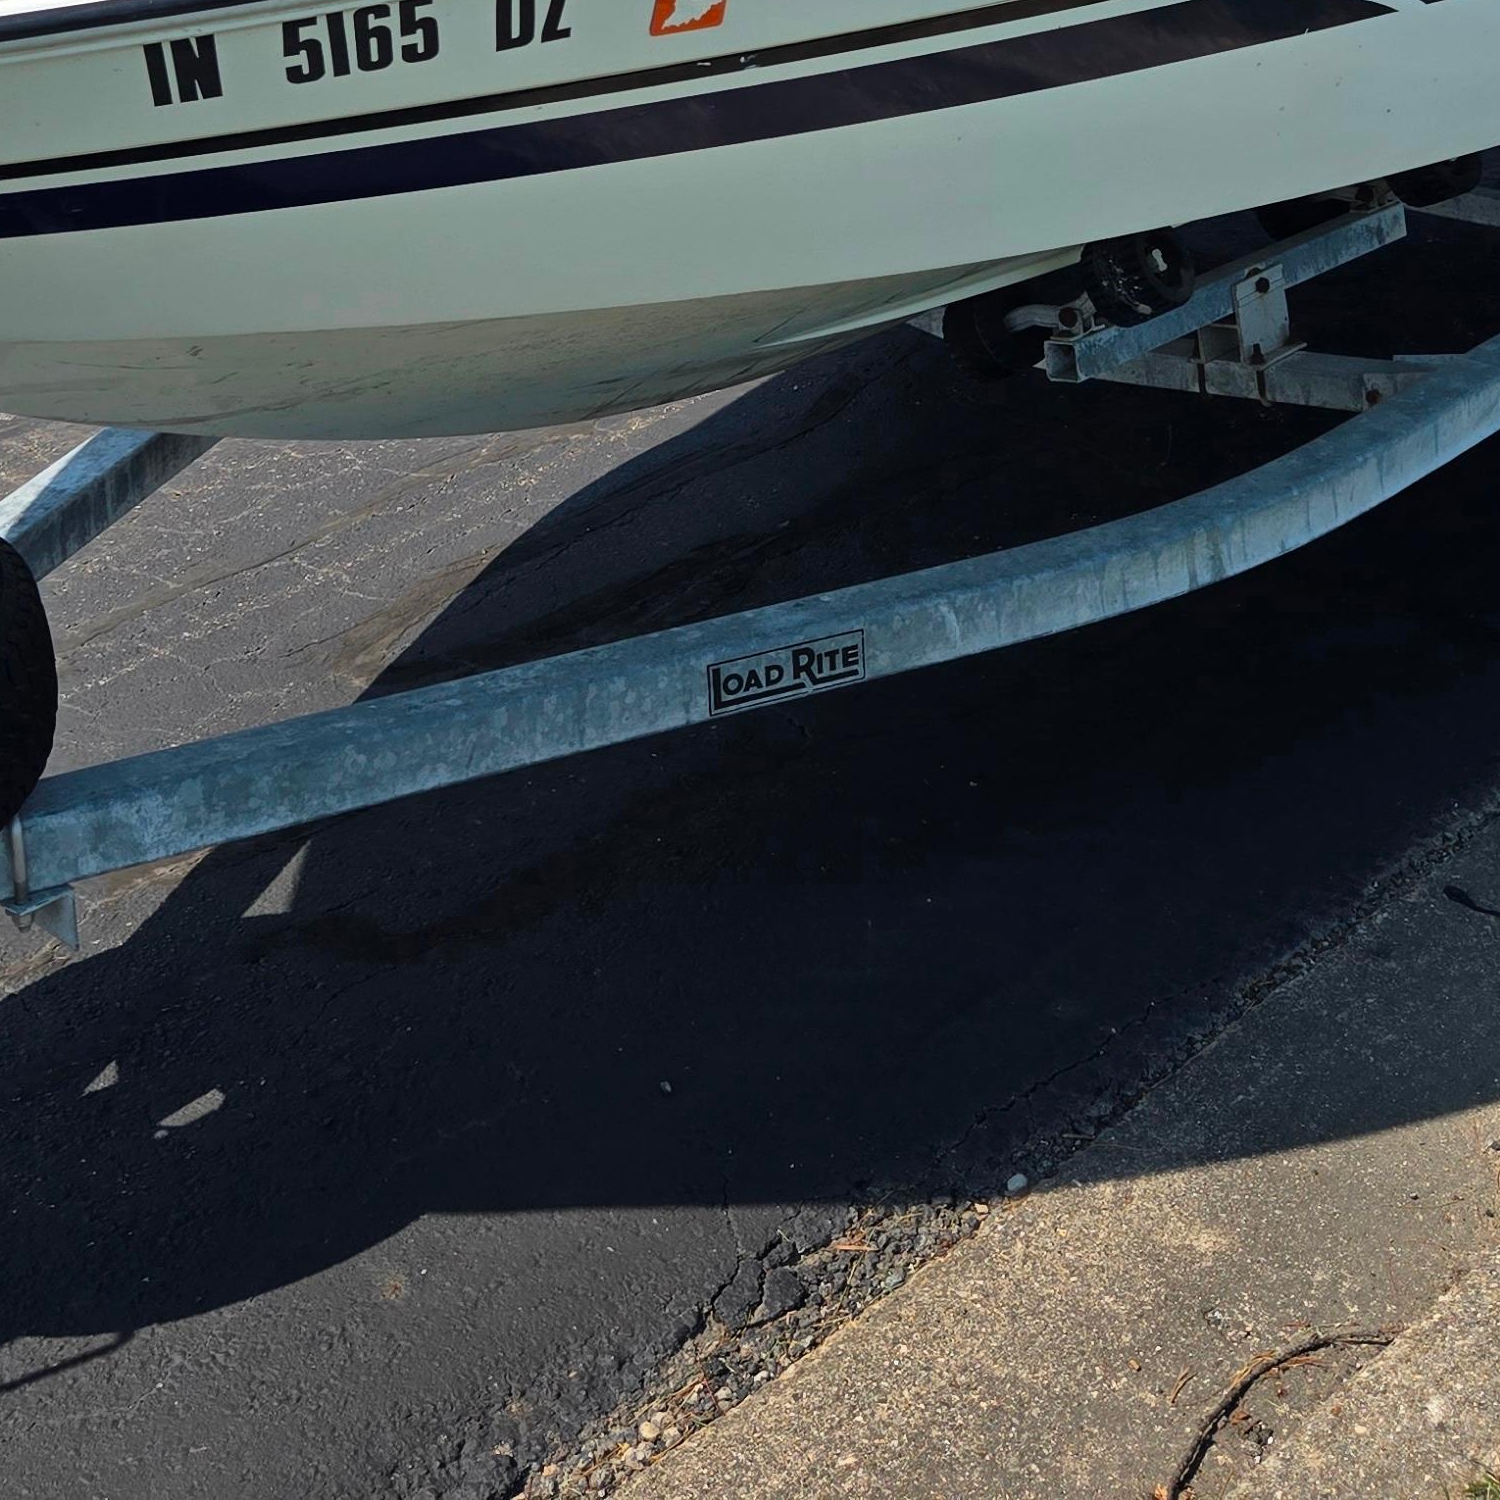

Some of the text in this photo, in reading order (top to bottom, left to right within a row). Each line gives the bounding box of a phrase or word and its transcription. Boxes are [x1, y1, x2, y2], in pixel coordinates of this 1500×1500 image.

[143, 34, 223, 106] IN
[712, 644, 860, 710] LOAD RITE
